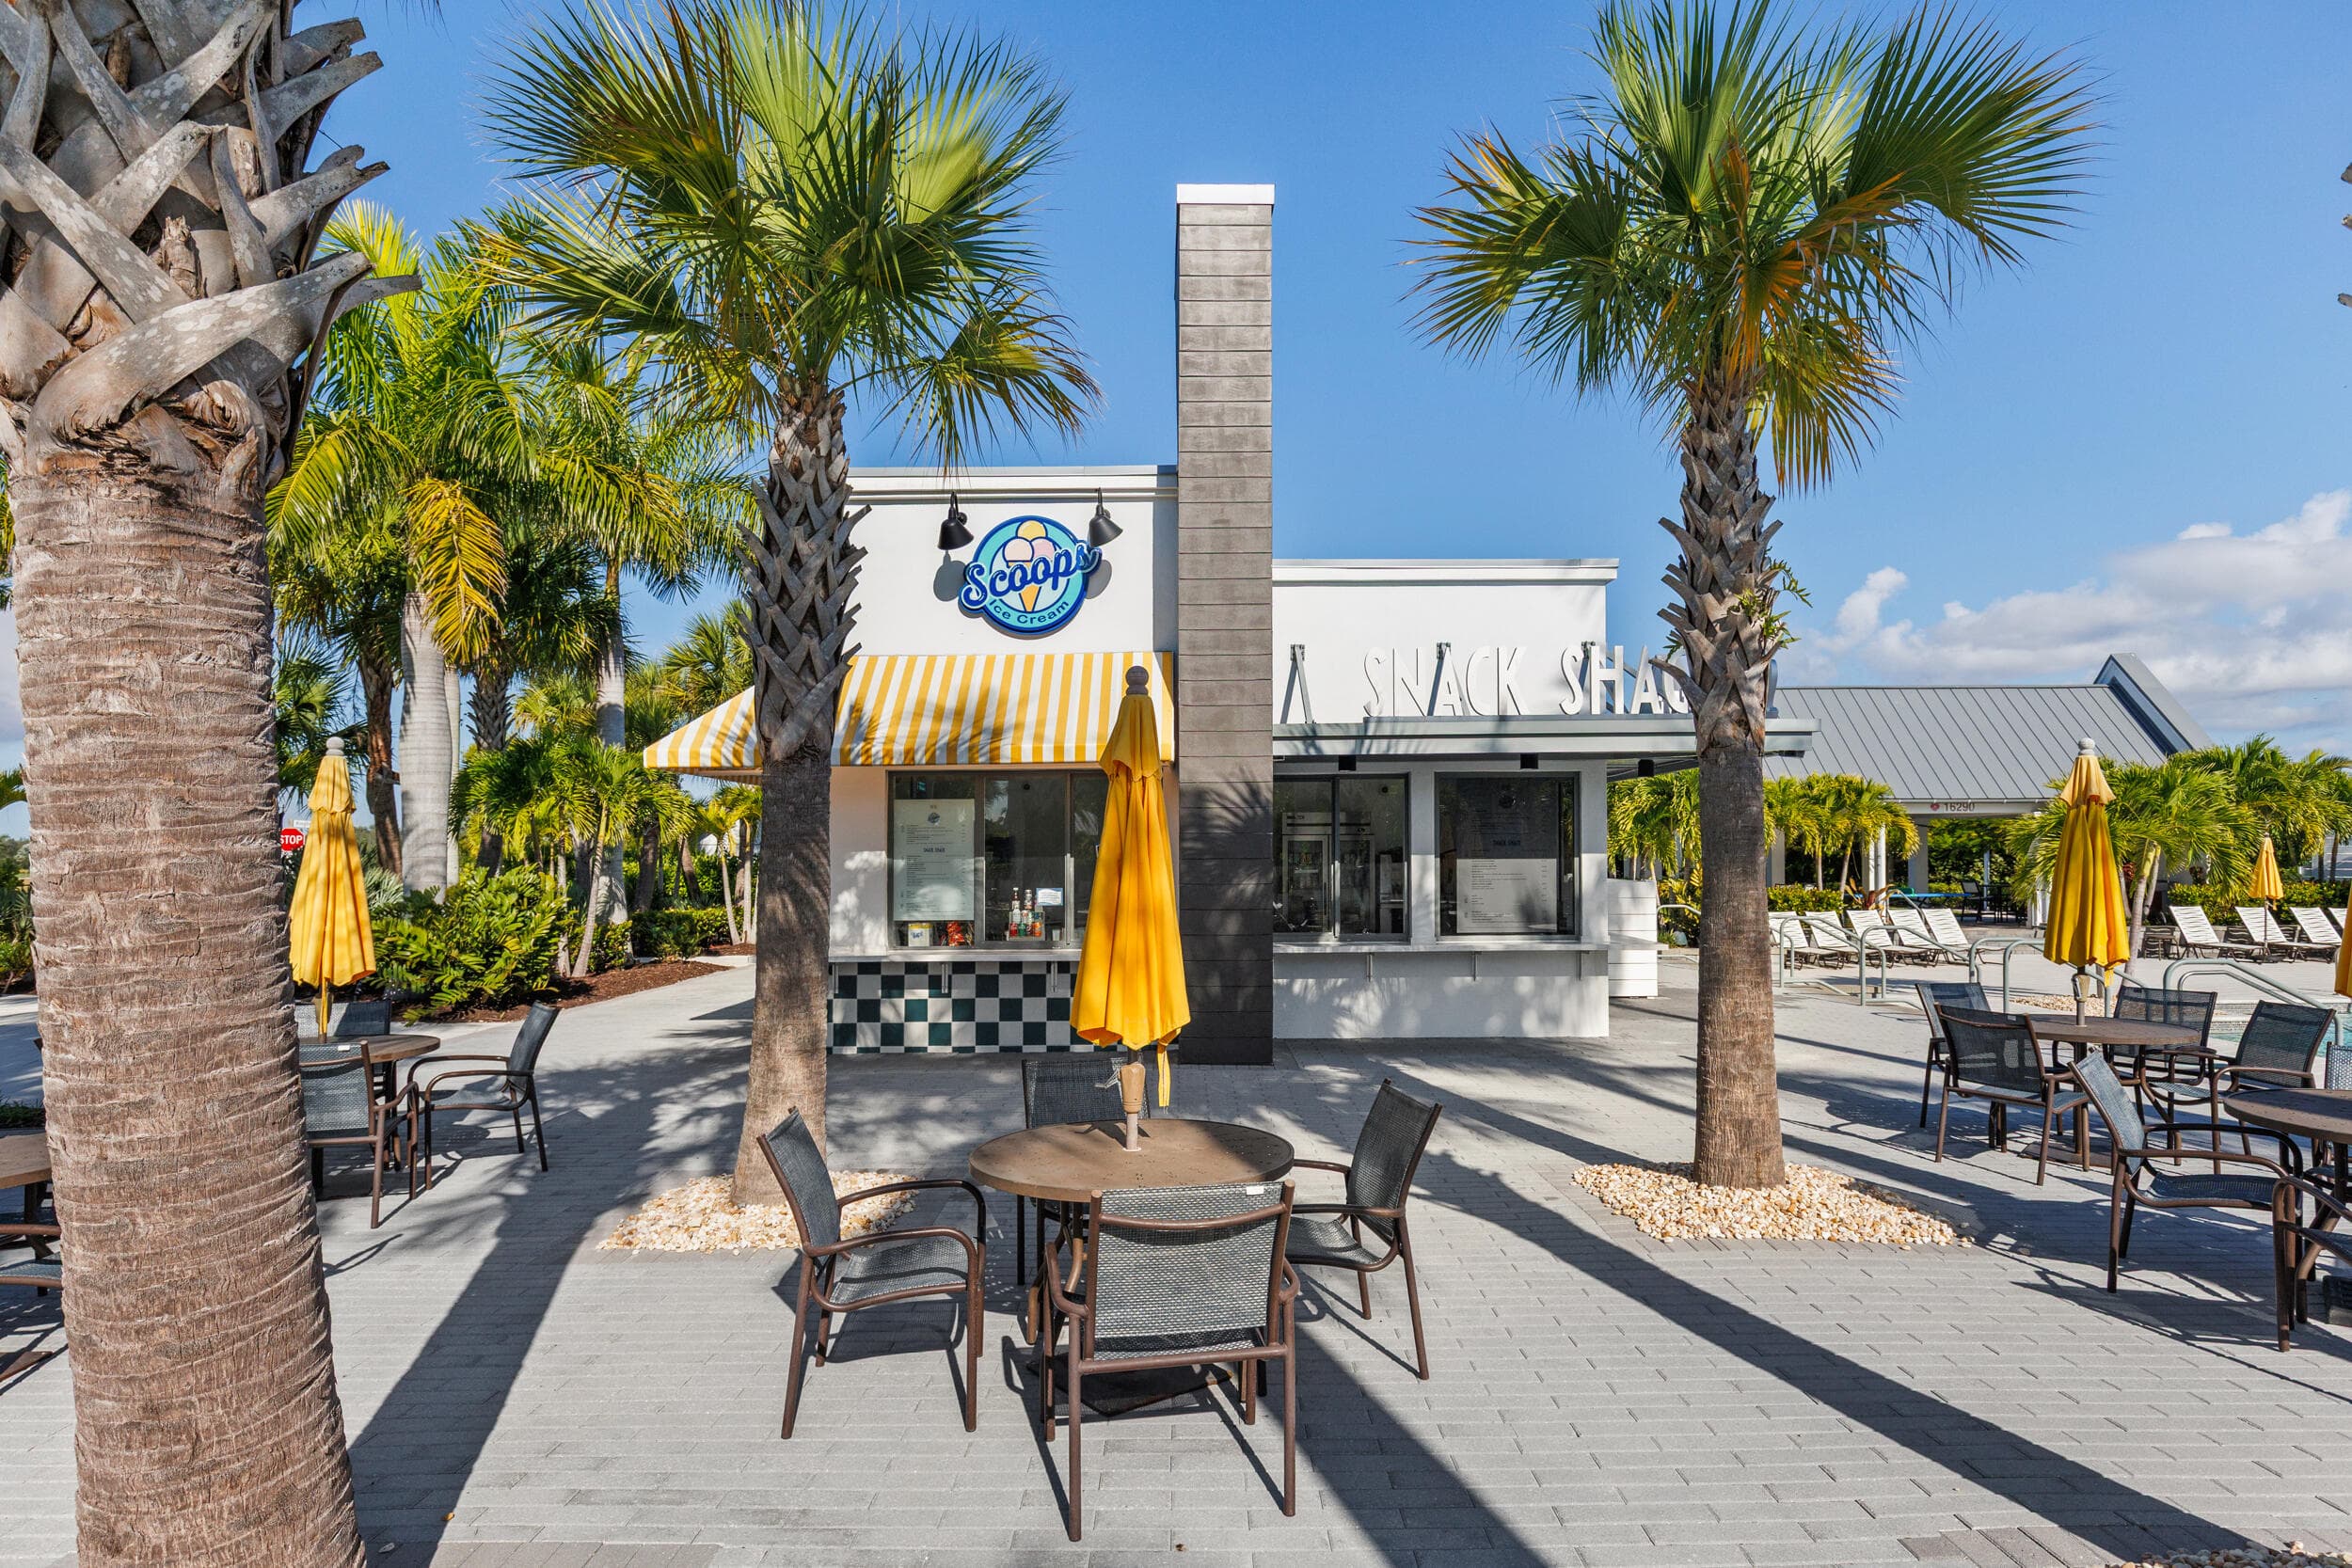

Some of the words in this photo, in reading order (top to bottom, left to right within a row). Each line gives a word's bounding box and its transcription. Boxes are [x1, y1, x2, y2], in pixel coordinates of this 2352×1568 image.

[962, 543, 1100, 607] Scoops
[989, 599, 1011, 620] Ice
[1016, 601, 1070, 625] Cream
[1363, 646, 1531, 717] SNACK
[1558, 644, 1692, 716] SHAC
[1944, 802, 1975, 812] 16290
[280, 835, 303, 845] STOP
